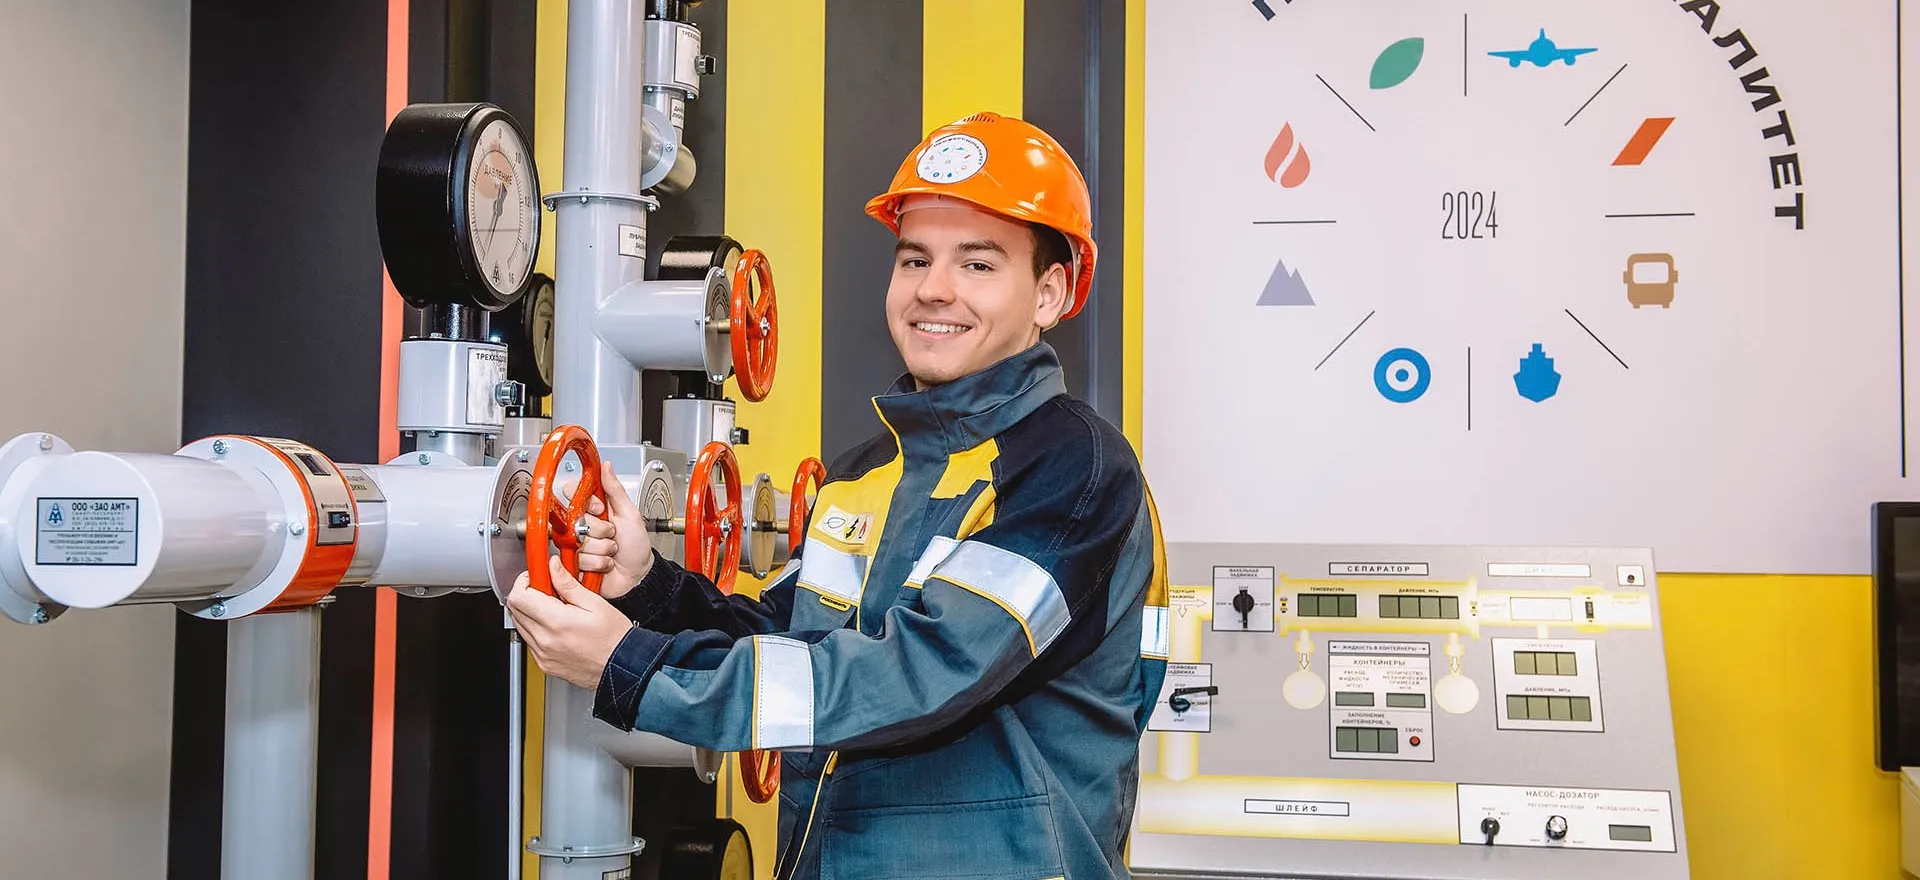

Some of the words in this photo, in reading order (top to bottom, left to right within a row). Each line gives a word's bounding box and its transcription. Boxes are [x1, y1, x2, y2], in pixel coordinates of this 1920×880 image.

[1673, 0, 1804, 230] АЛИТЕТ
[515, 152, 522, 165] 10
[524, 196, 531, 207] 12
[1442, 190, 1498, 239] 2024
[72, 502, 88, 511] ООО
[89, 502, 109, 511] «ЗАО
[110, 502, 130, 511] АМТ»
[1347, 565, 1411, 573] СЕПАРАТОР
[1525, 789, 1600, 800] НАСОС-ДОЗАТОР
[1275, 803, 1318, 813] ШЛЕЙФ
